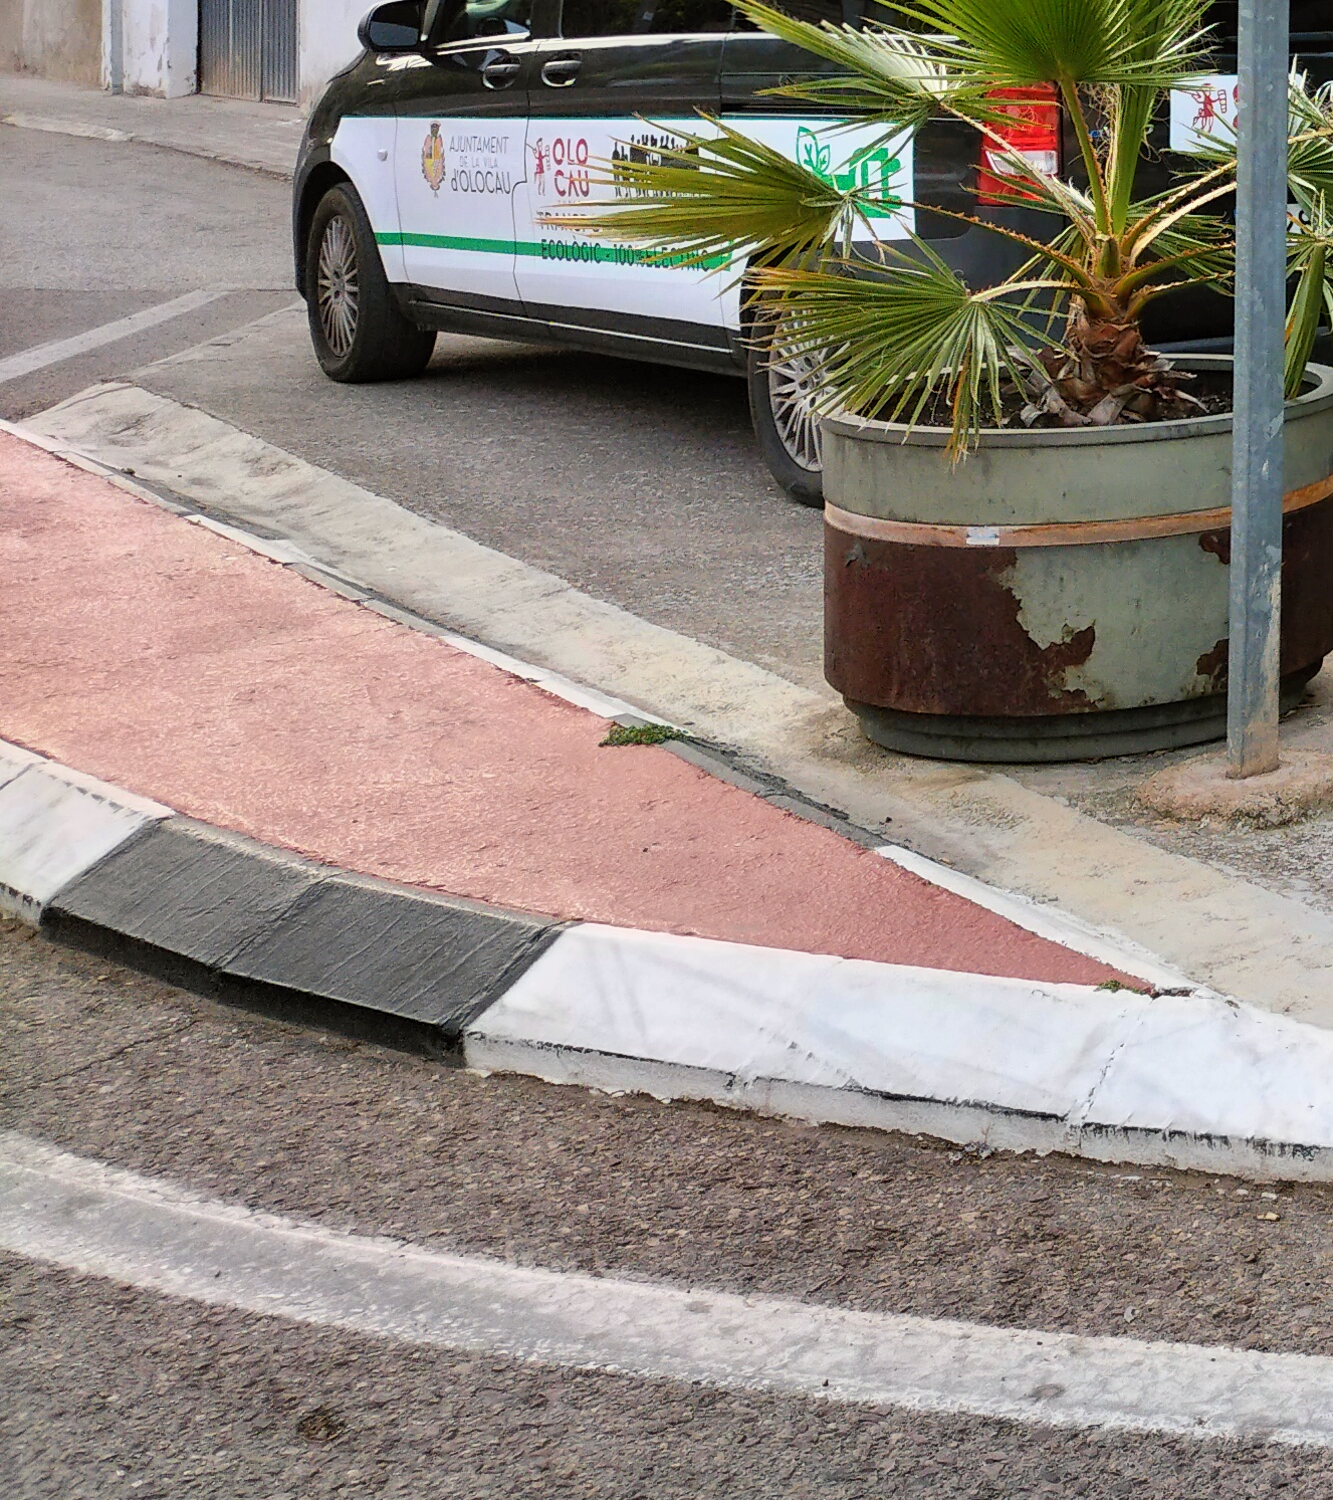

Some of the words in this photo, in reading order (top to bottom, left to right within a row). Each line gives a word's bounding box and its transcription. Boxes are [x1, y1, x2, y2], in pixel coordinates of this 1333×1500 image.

[449, 136, 510, 154] AJUNTAMENT
[552, 138, 589, 165] OLO
[459, 156, 468, 167] DE
[471, 157, 480, 168] LA
[483, 158, 499, 170] VILA
[451, 169, 512, 195] d'OLOCAU
[554, 170, 589, 198] CAU
